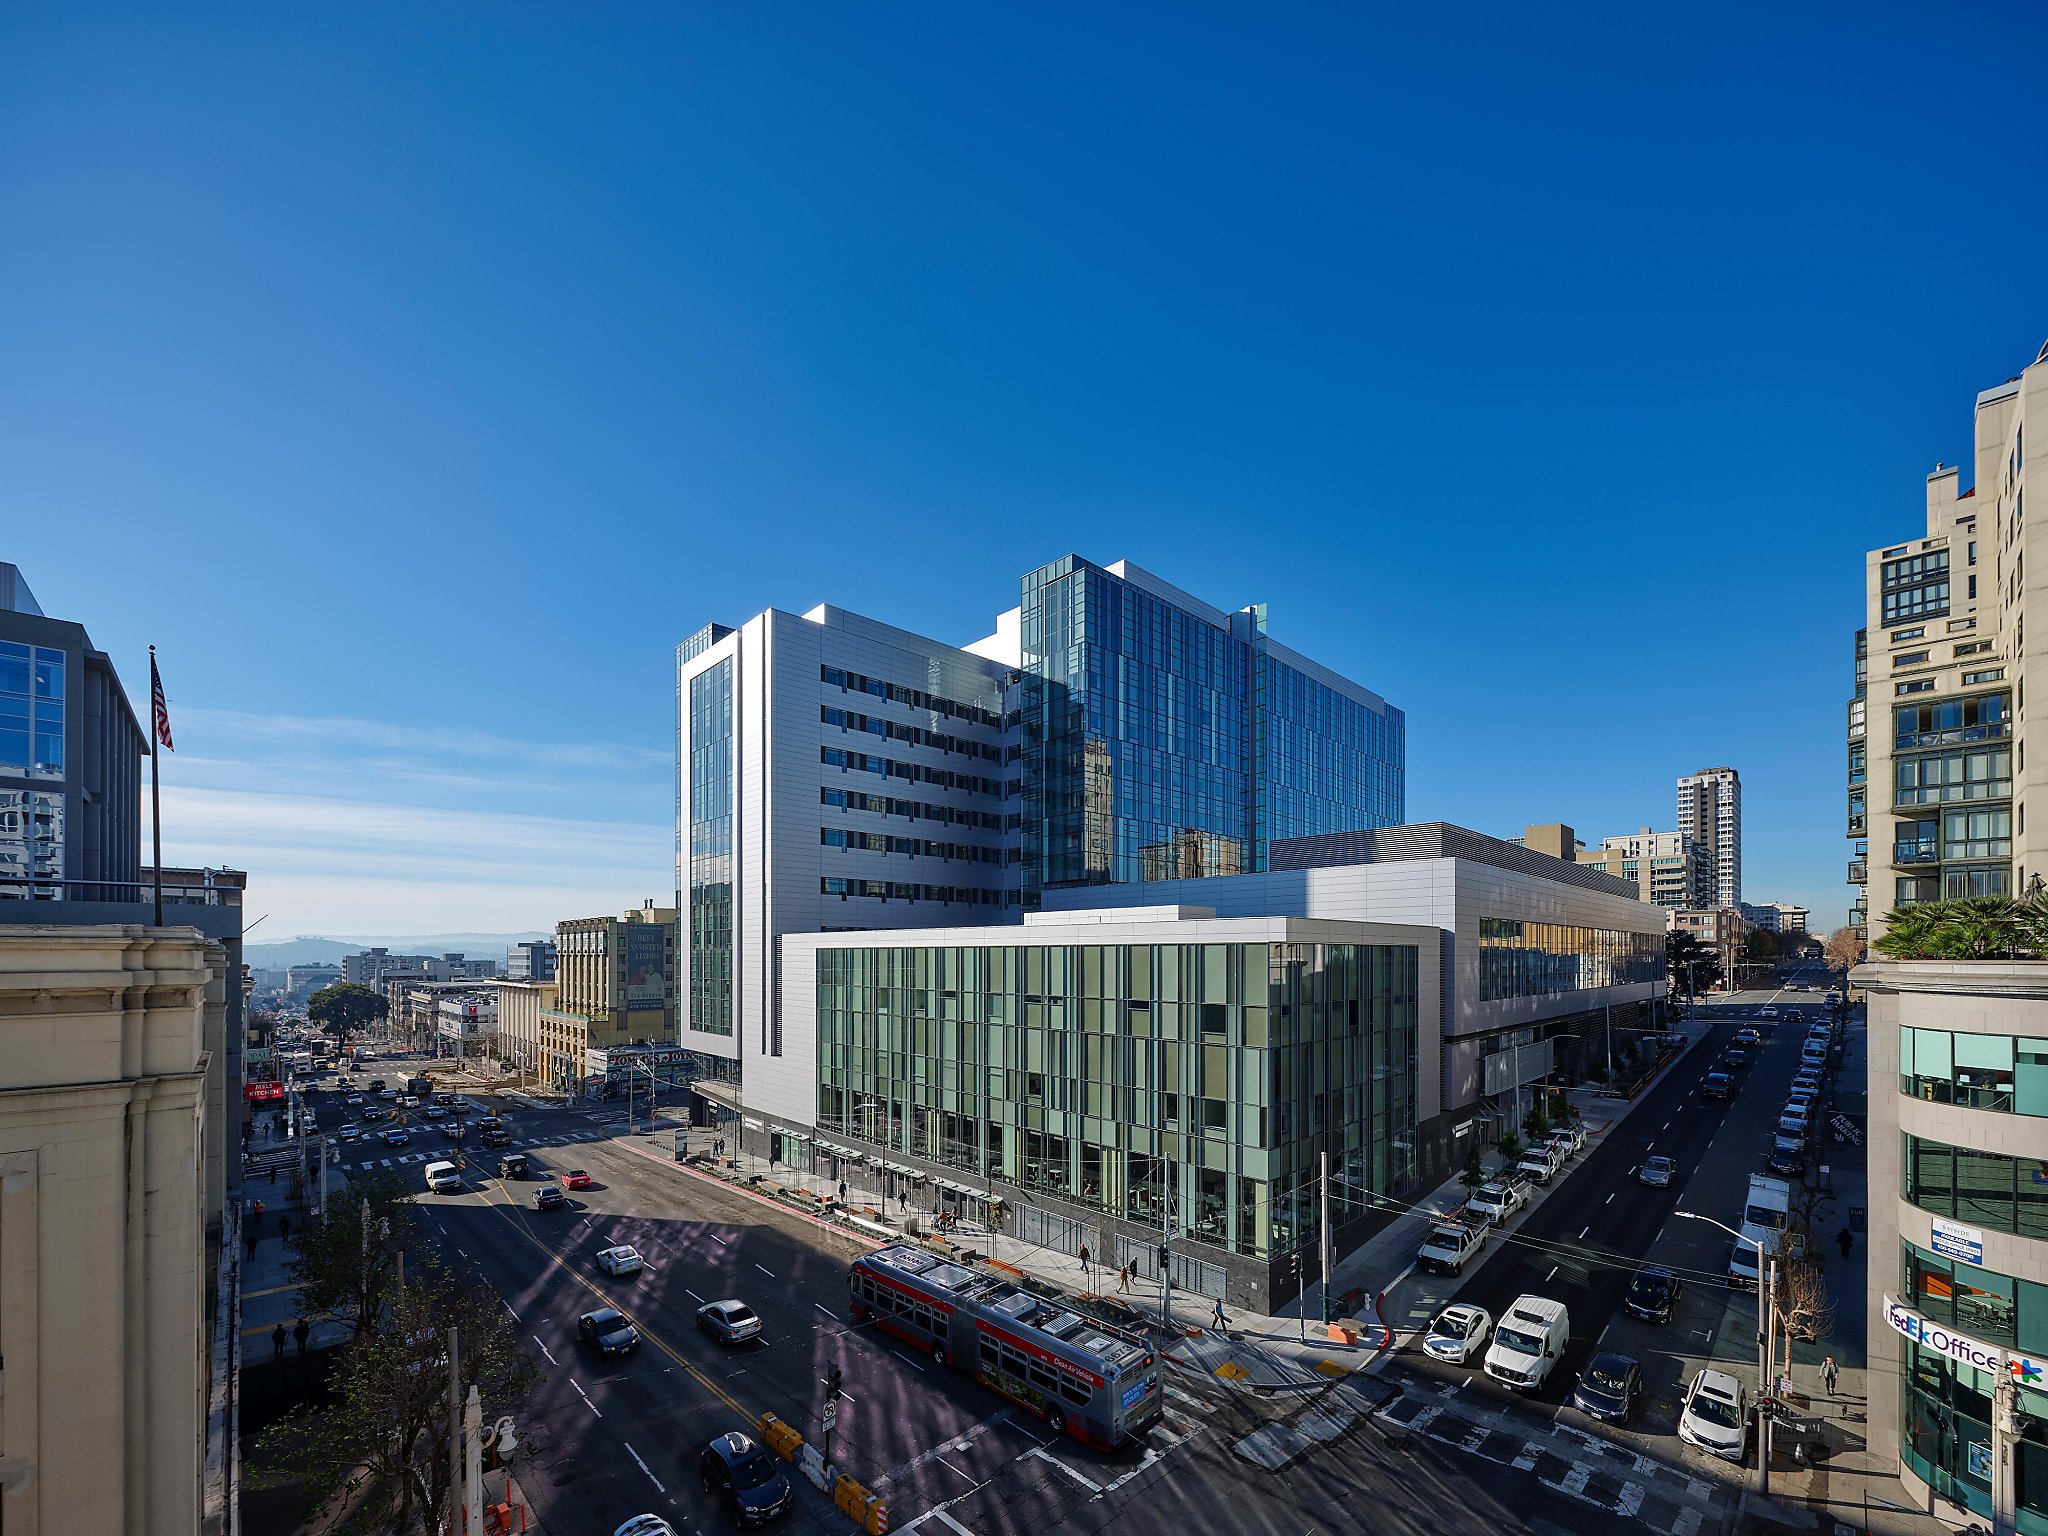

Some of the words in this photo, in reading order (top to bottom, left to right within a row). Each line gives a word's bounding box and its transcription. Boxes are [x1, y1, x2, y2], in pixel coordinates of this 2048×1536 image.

[630, 943, 662, 951] ASSISTED
[635, 952, 659, 960] LIVING
[249, 1089, 279, 1097] KITCHEN
[1830, 1117, 1863, 1146] PARKING
[1836, 1114, 1863, 1137] PUBLIC
[1940, 1232, 1970, 1246] AVAILABLE
[1890, 1304, 1931, 1345] FedEx
[1932, 1331, 1998, 1371] Office
[1104, 1345, 1133, 1362] 6673
[1053, 1357, 1068, 1370] Clean
[1067, 1364, 1076, 1373] Air
[1076, 1367, 1094, 1383] Vehicle
